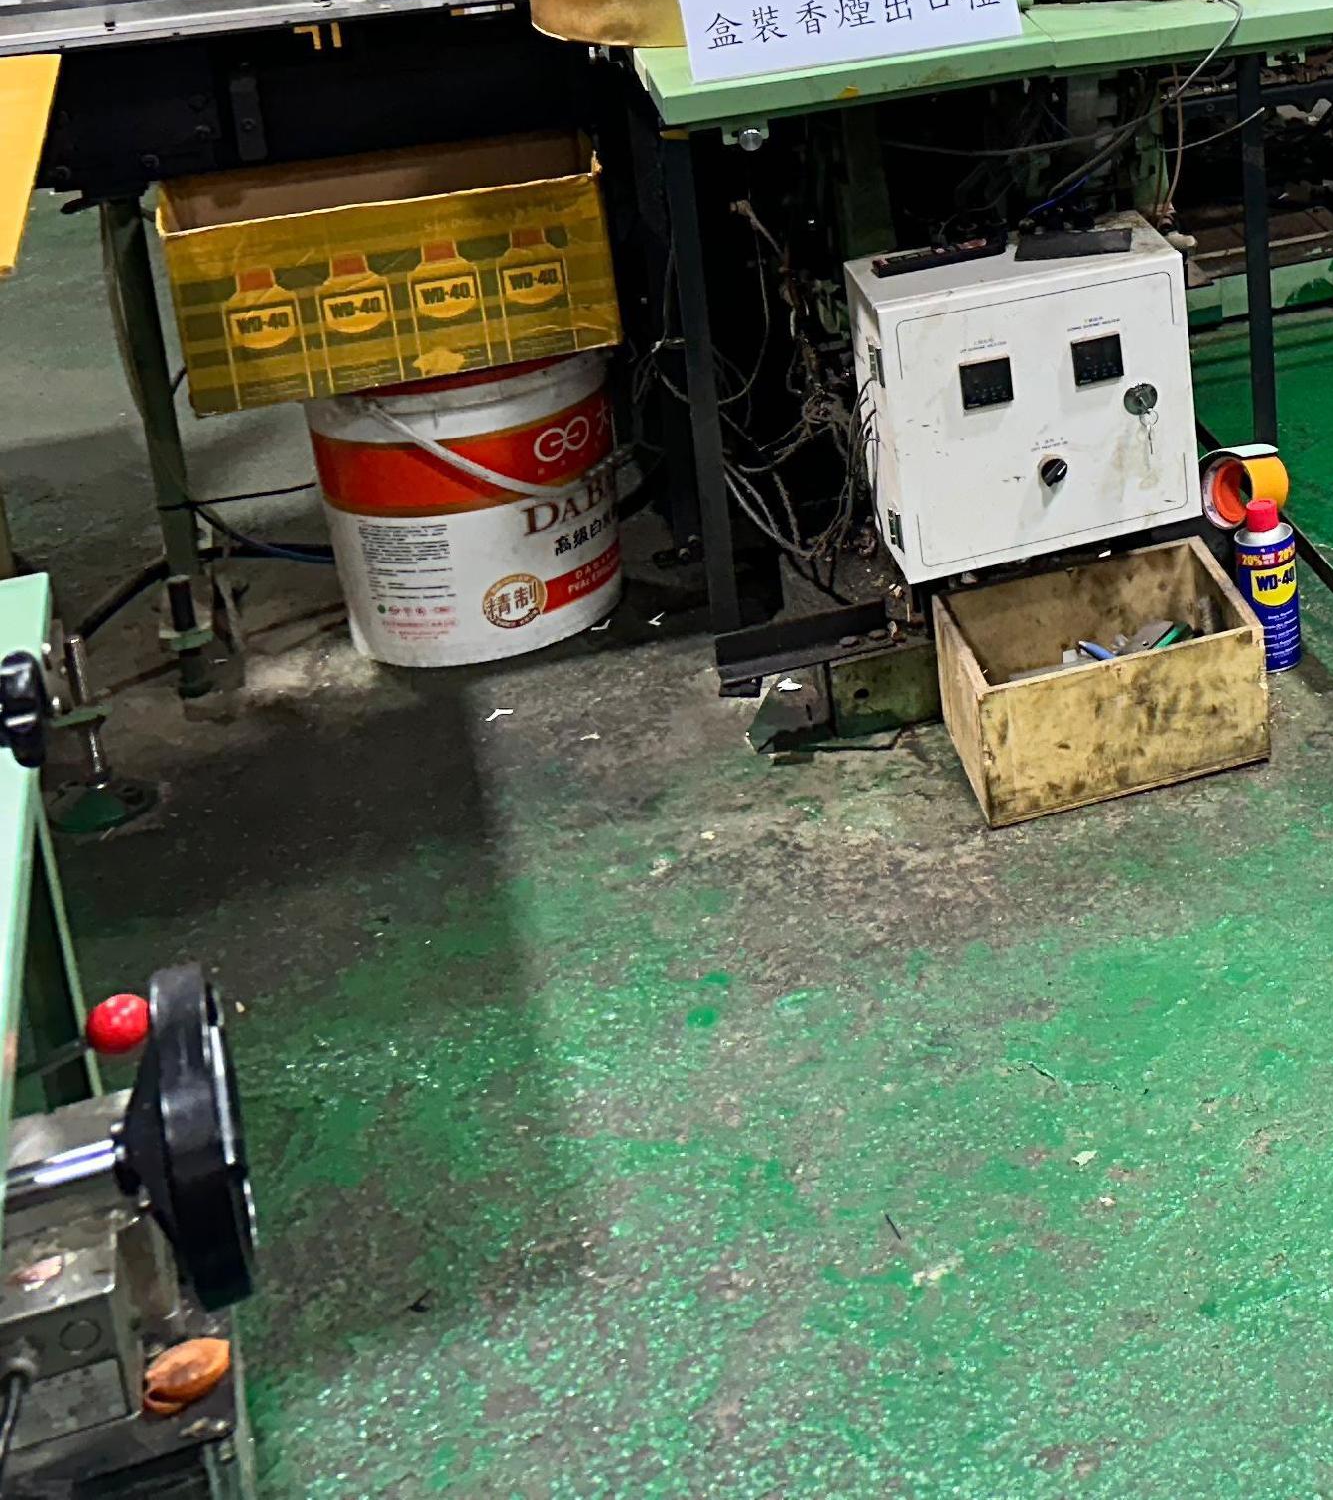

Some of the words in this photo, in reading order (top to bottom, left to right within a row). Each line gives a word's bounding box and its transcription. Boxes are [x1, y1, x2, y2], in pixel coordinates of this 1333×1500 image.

[508, 267, 559, 291] WD-40
[419, 282, 472, 305] WD-40
[328, 297, 381, 319] WD-40
[236, 312, 289, 334] WD-40
[1254, 565, 1295, 592] WD-40
[485, 580, 537, 620] 精制
